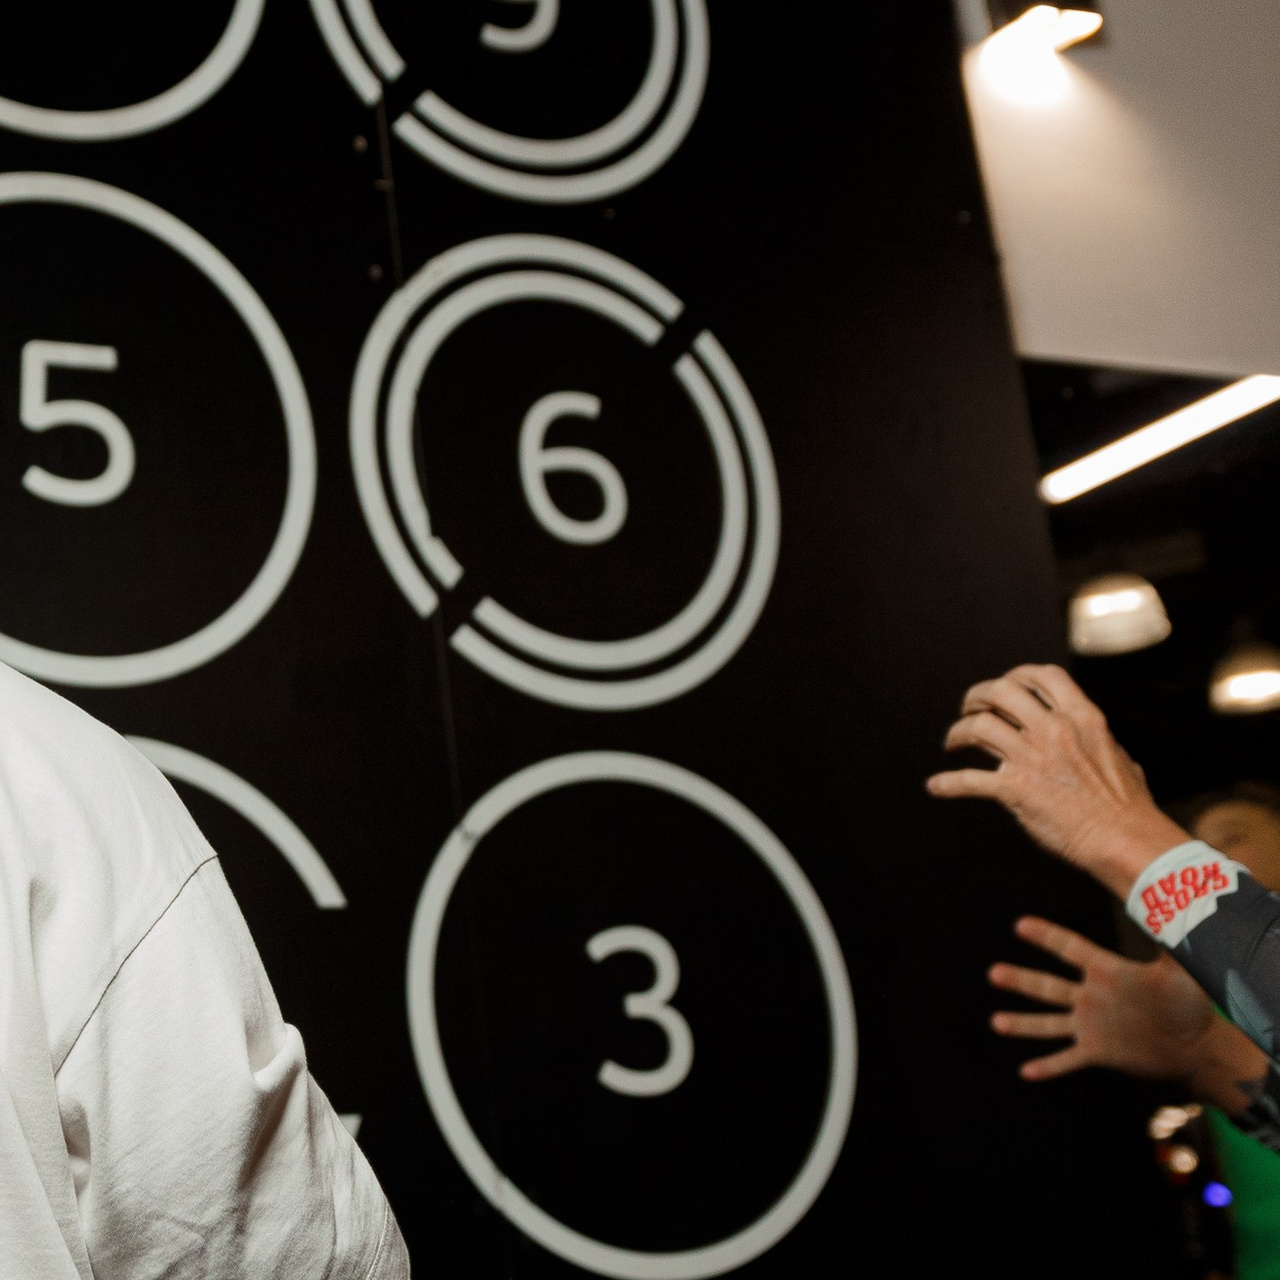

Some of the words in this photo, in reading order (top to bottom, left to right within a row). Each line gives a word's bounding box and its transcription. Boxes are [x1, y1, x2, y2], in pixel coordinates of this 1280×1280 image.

[19, 339, 136, 507] 5
[518, 391, 628, 545] 6
[1146, 874, 1229, 934] CROSS
[586, 925, 694, 1097] 3
